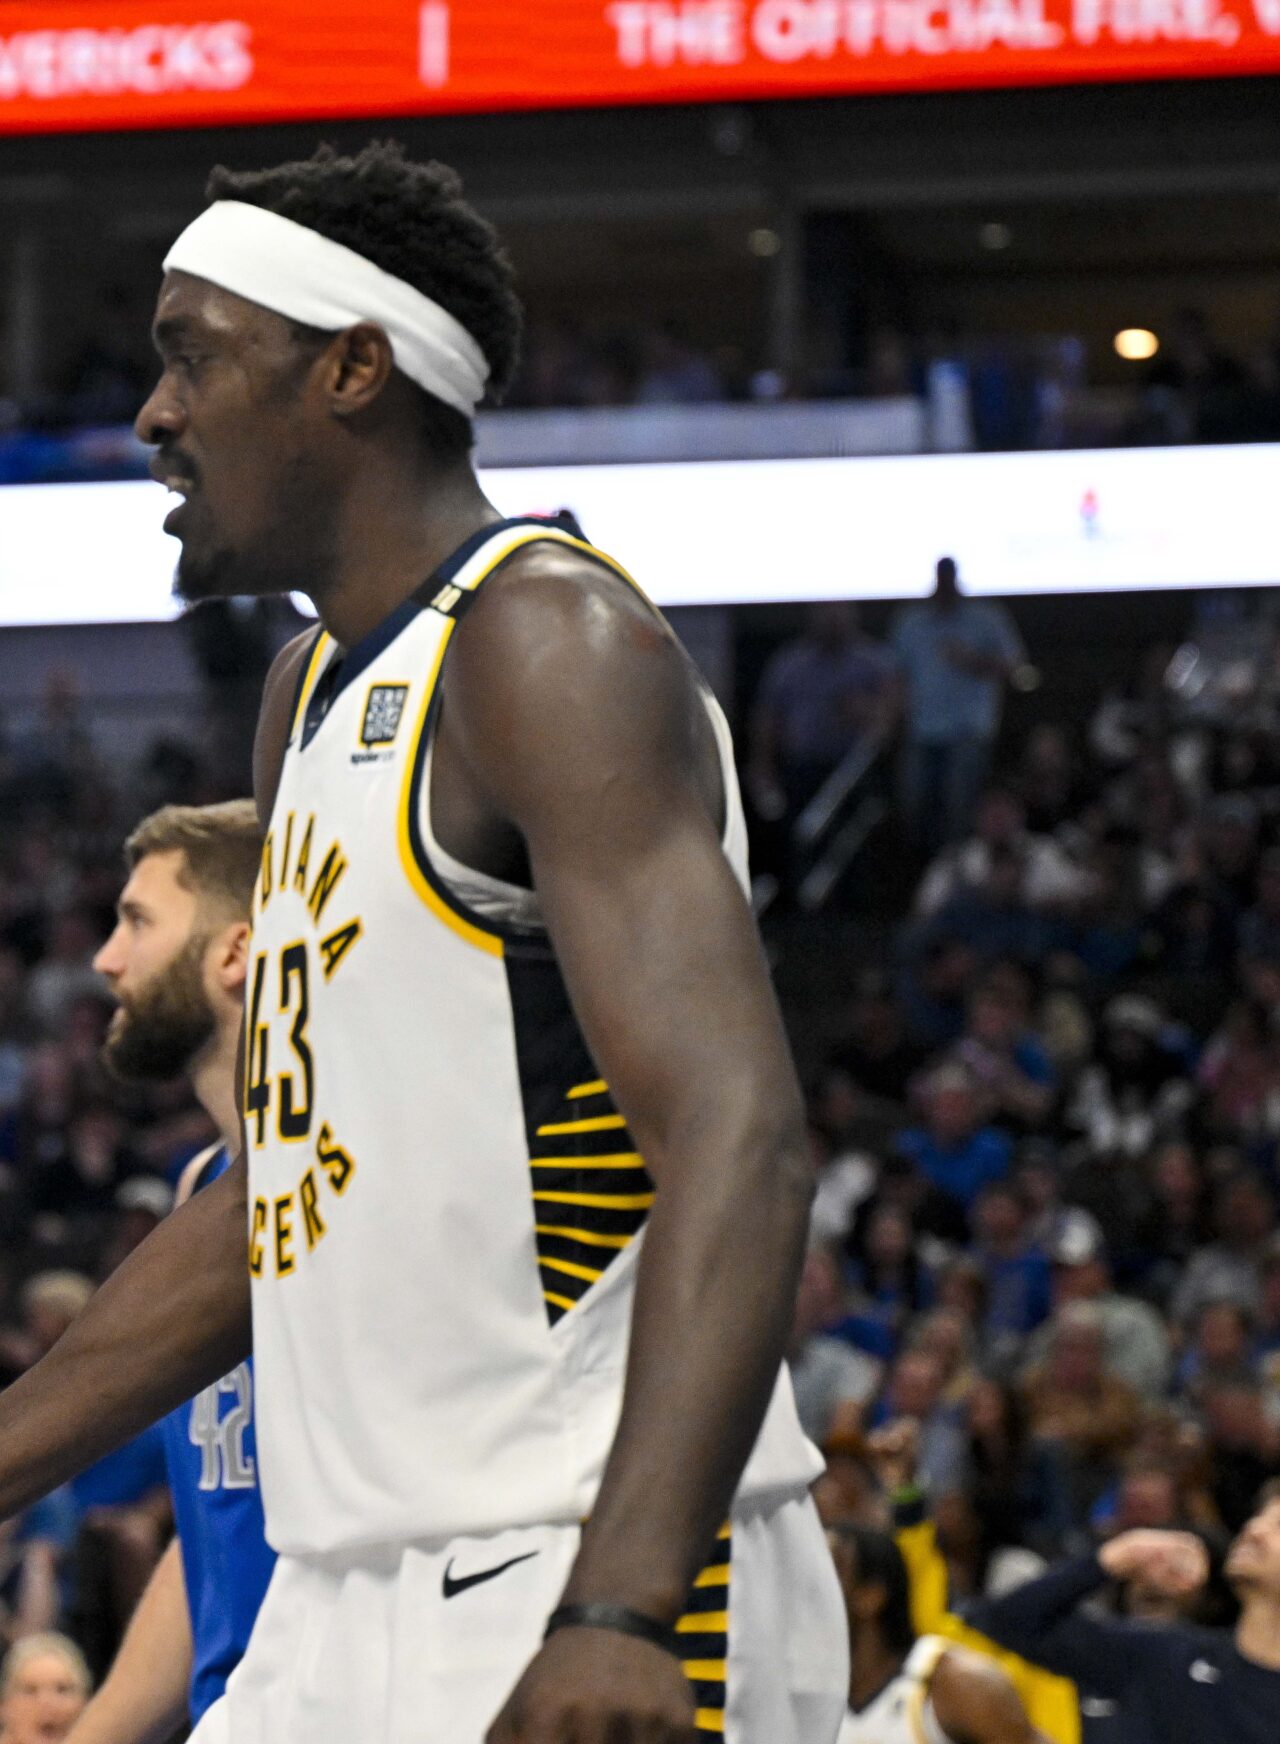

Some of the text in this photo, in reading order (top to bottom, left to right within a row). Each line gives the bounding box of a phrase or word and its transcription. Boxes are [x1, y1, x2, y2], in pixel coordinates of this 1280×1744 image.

[603, 0, 745, 67] THE
[751, 0, 1066, 63] OFFICIAL
[248, 809, 364, 985] DIANA
[244, 937, 315, 1150] 43
[189, 1360, 257, 1491] 42
